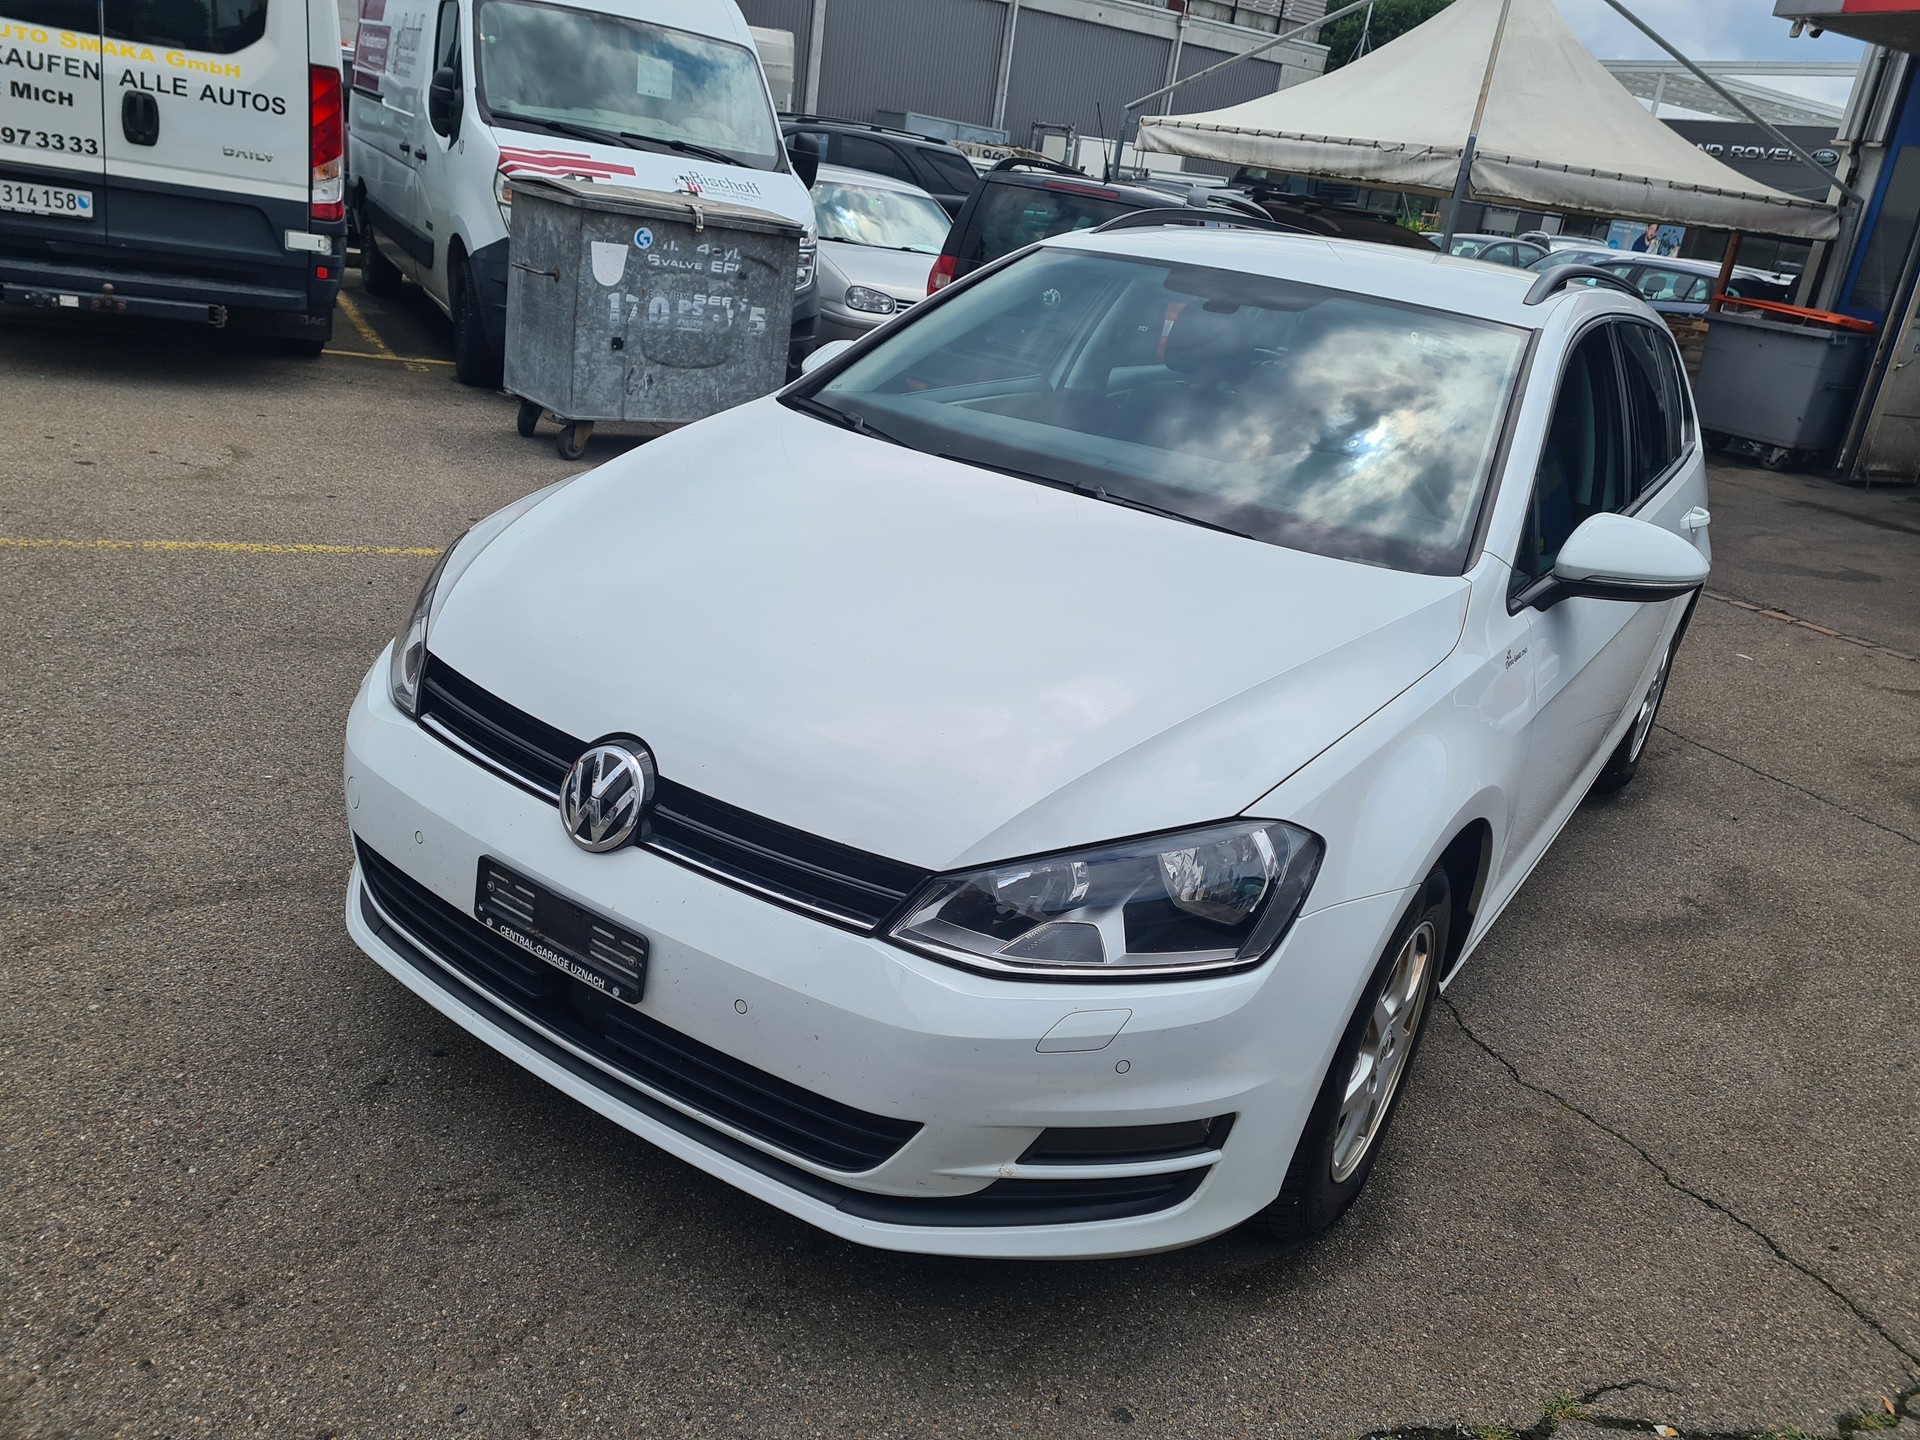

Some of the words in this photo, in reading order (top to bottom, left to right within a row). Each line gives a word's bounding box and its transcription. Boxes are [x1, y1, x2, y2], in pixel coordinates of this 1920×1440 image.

[165, 51, 241, 79] GmbH
[119, 69, 188, 97] ALLE
[199, 84, 287, 115] AUTOS
[688, 170, 762, 196] Bischoff
[499, 924, 570, 970] CENTRAL-GARAGE
[569, 962, 606, 990] UZNACH
